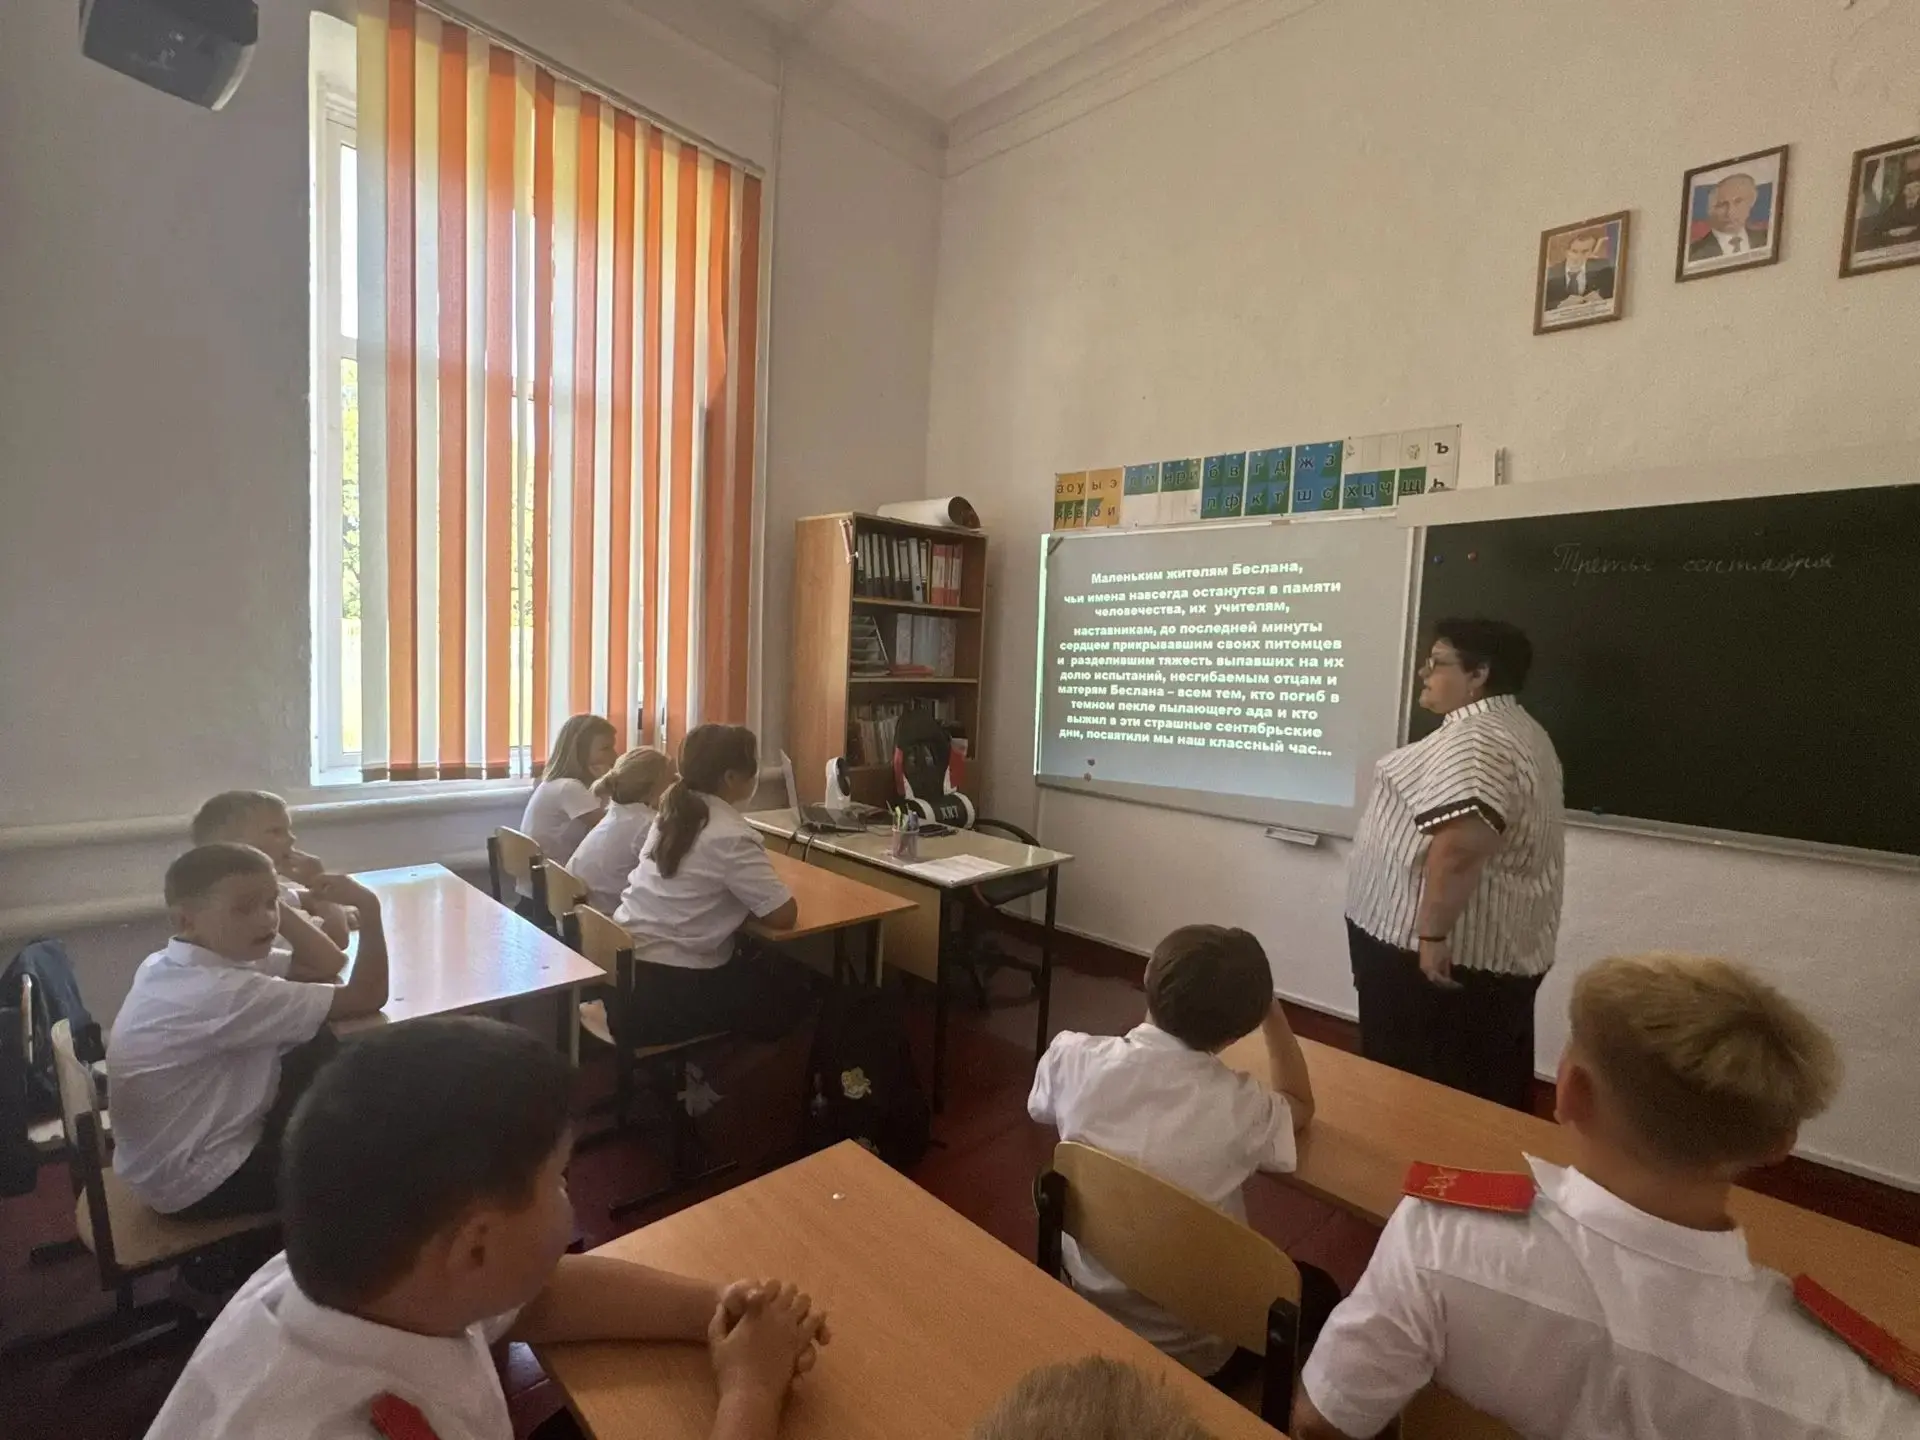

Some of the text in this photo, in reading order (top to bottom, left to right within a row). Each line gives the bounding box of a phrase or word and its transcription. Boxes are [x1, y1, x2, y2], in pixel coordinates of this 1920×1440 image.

[1091, 562, 1303, 584] Маленьким жителям Беслана,
[1064, 582, 1341, 604] чьи имена навсегда останутся в памяти
[1095, 601, 1290, 616] человечества, их учителям,
[1073, 621, 1322, 636] наставникам, до последней минуты
[1060, 640, 1342, 653] сердцем прикрывавшим своих питомцев
[1057, 656, 1344, 668] и разделившим тяжесть выпавших на их
[1060, 670, 1337, 686] долю испытаний, несгибаемым отцам и
[1058, 685, 1107, 696] матерям
[1110, 685, 1164, 696] Беслана
[1177, 689, 1212, 698] всем
[1215, 689, 1246, 701] тем,
[1250, 690, 1275, 700] кто
[1279, 690, 1326, 702] погиб
[1331, 693, 1340, 703] в
[1071, 700, 1318, 720] темном пекле пылающего ада и кто
[1067, 715, 1323, 738] выжил в эти страшные сентябрьские
[1059, 728, 1332, 756] дни, посвятили мы наш классный час...
